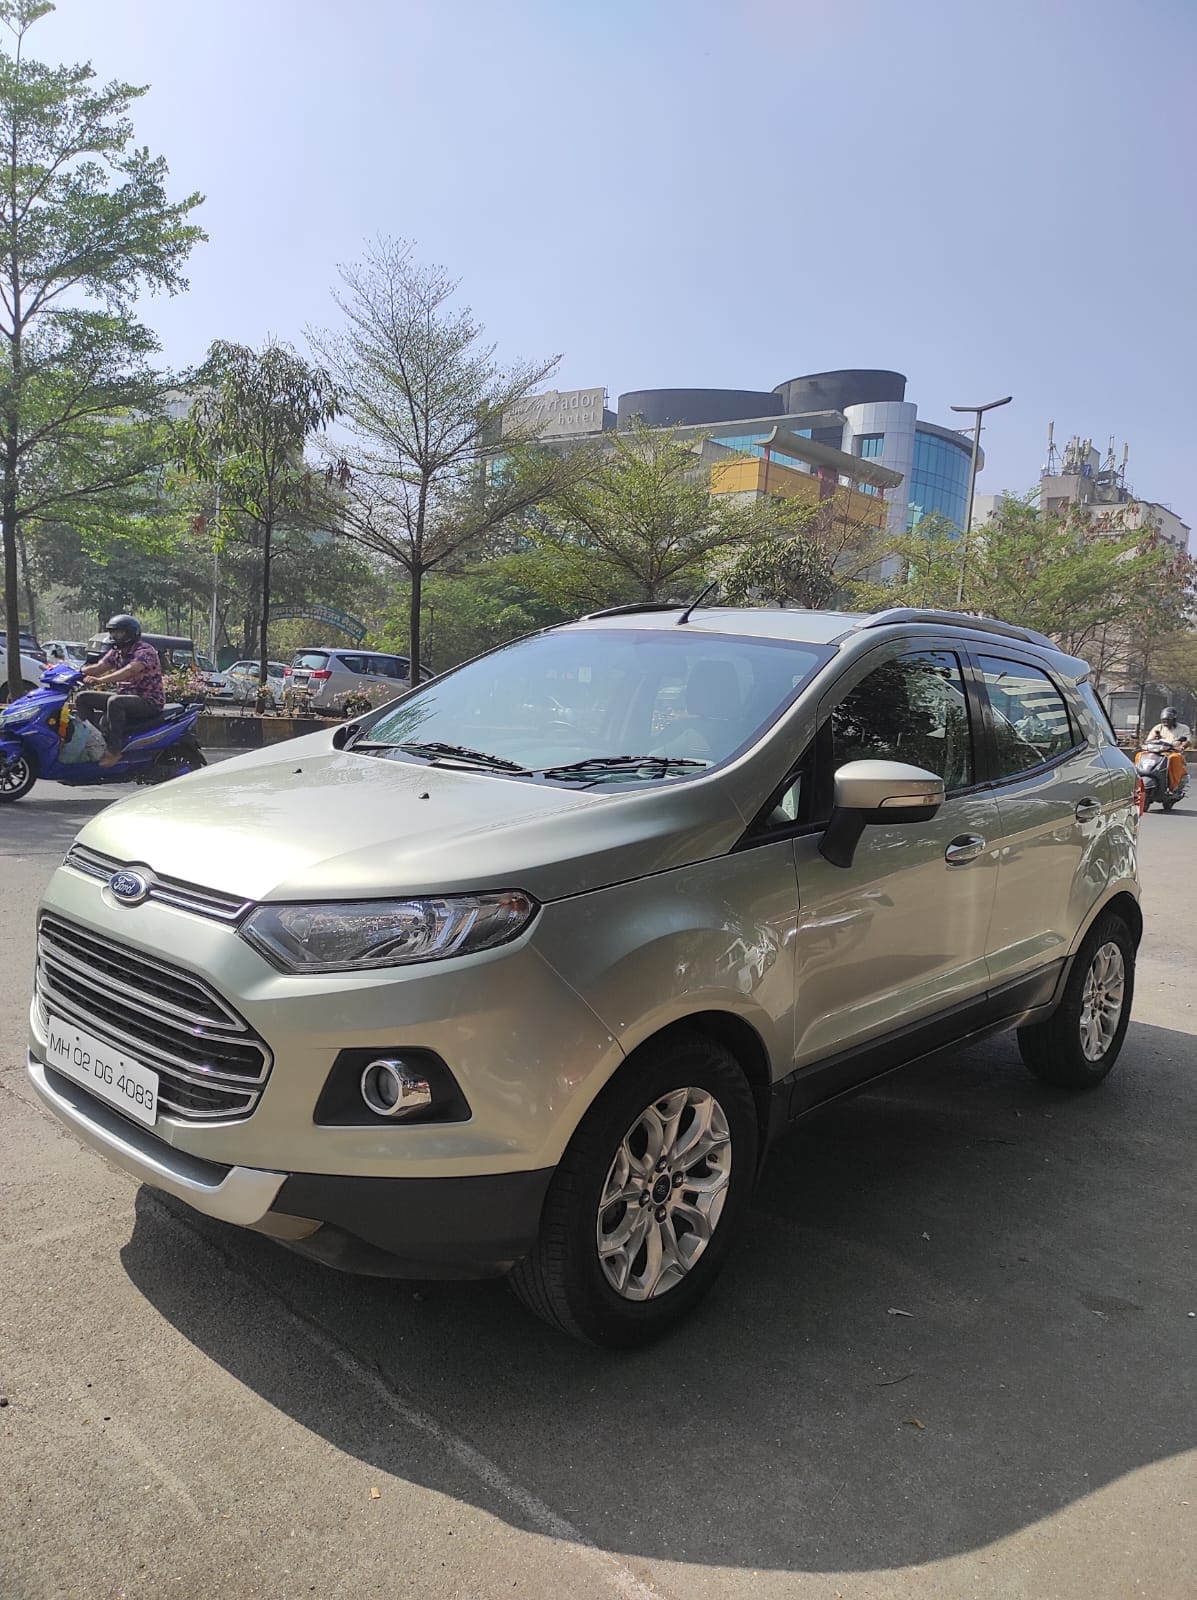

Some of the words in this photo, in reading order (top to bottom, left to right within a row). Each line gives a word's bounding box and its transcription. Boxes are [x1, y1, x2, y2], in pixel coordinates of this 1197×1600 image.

[558, 410, 595, 425] hotel
[113, 876, 136, 894] Ford
[50, 1033, 71, 1059] MH
[73, 1047, 91, 1072] 02
[94, 1059, 113, 1085] DG
[117, 1075, 154, 1111] 4083
